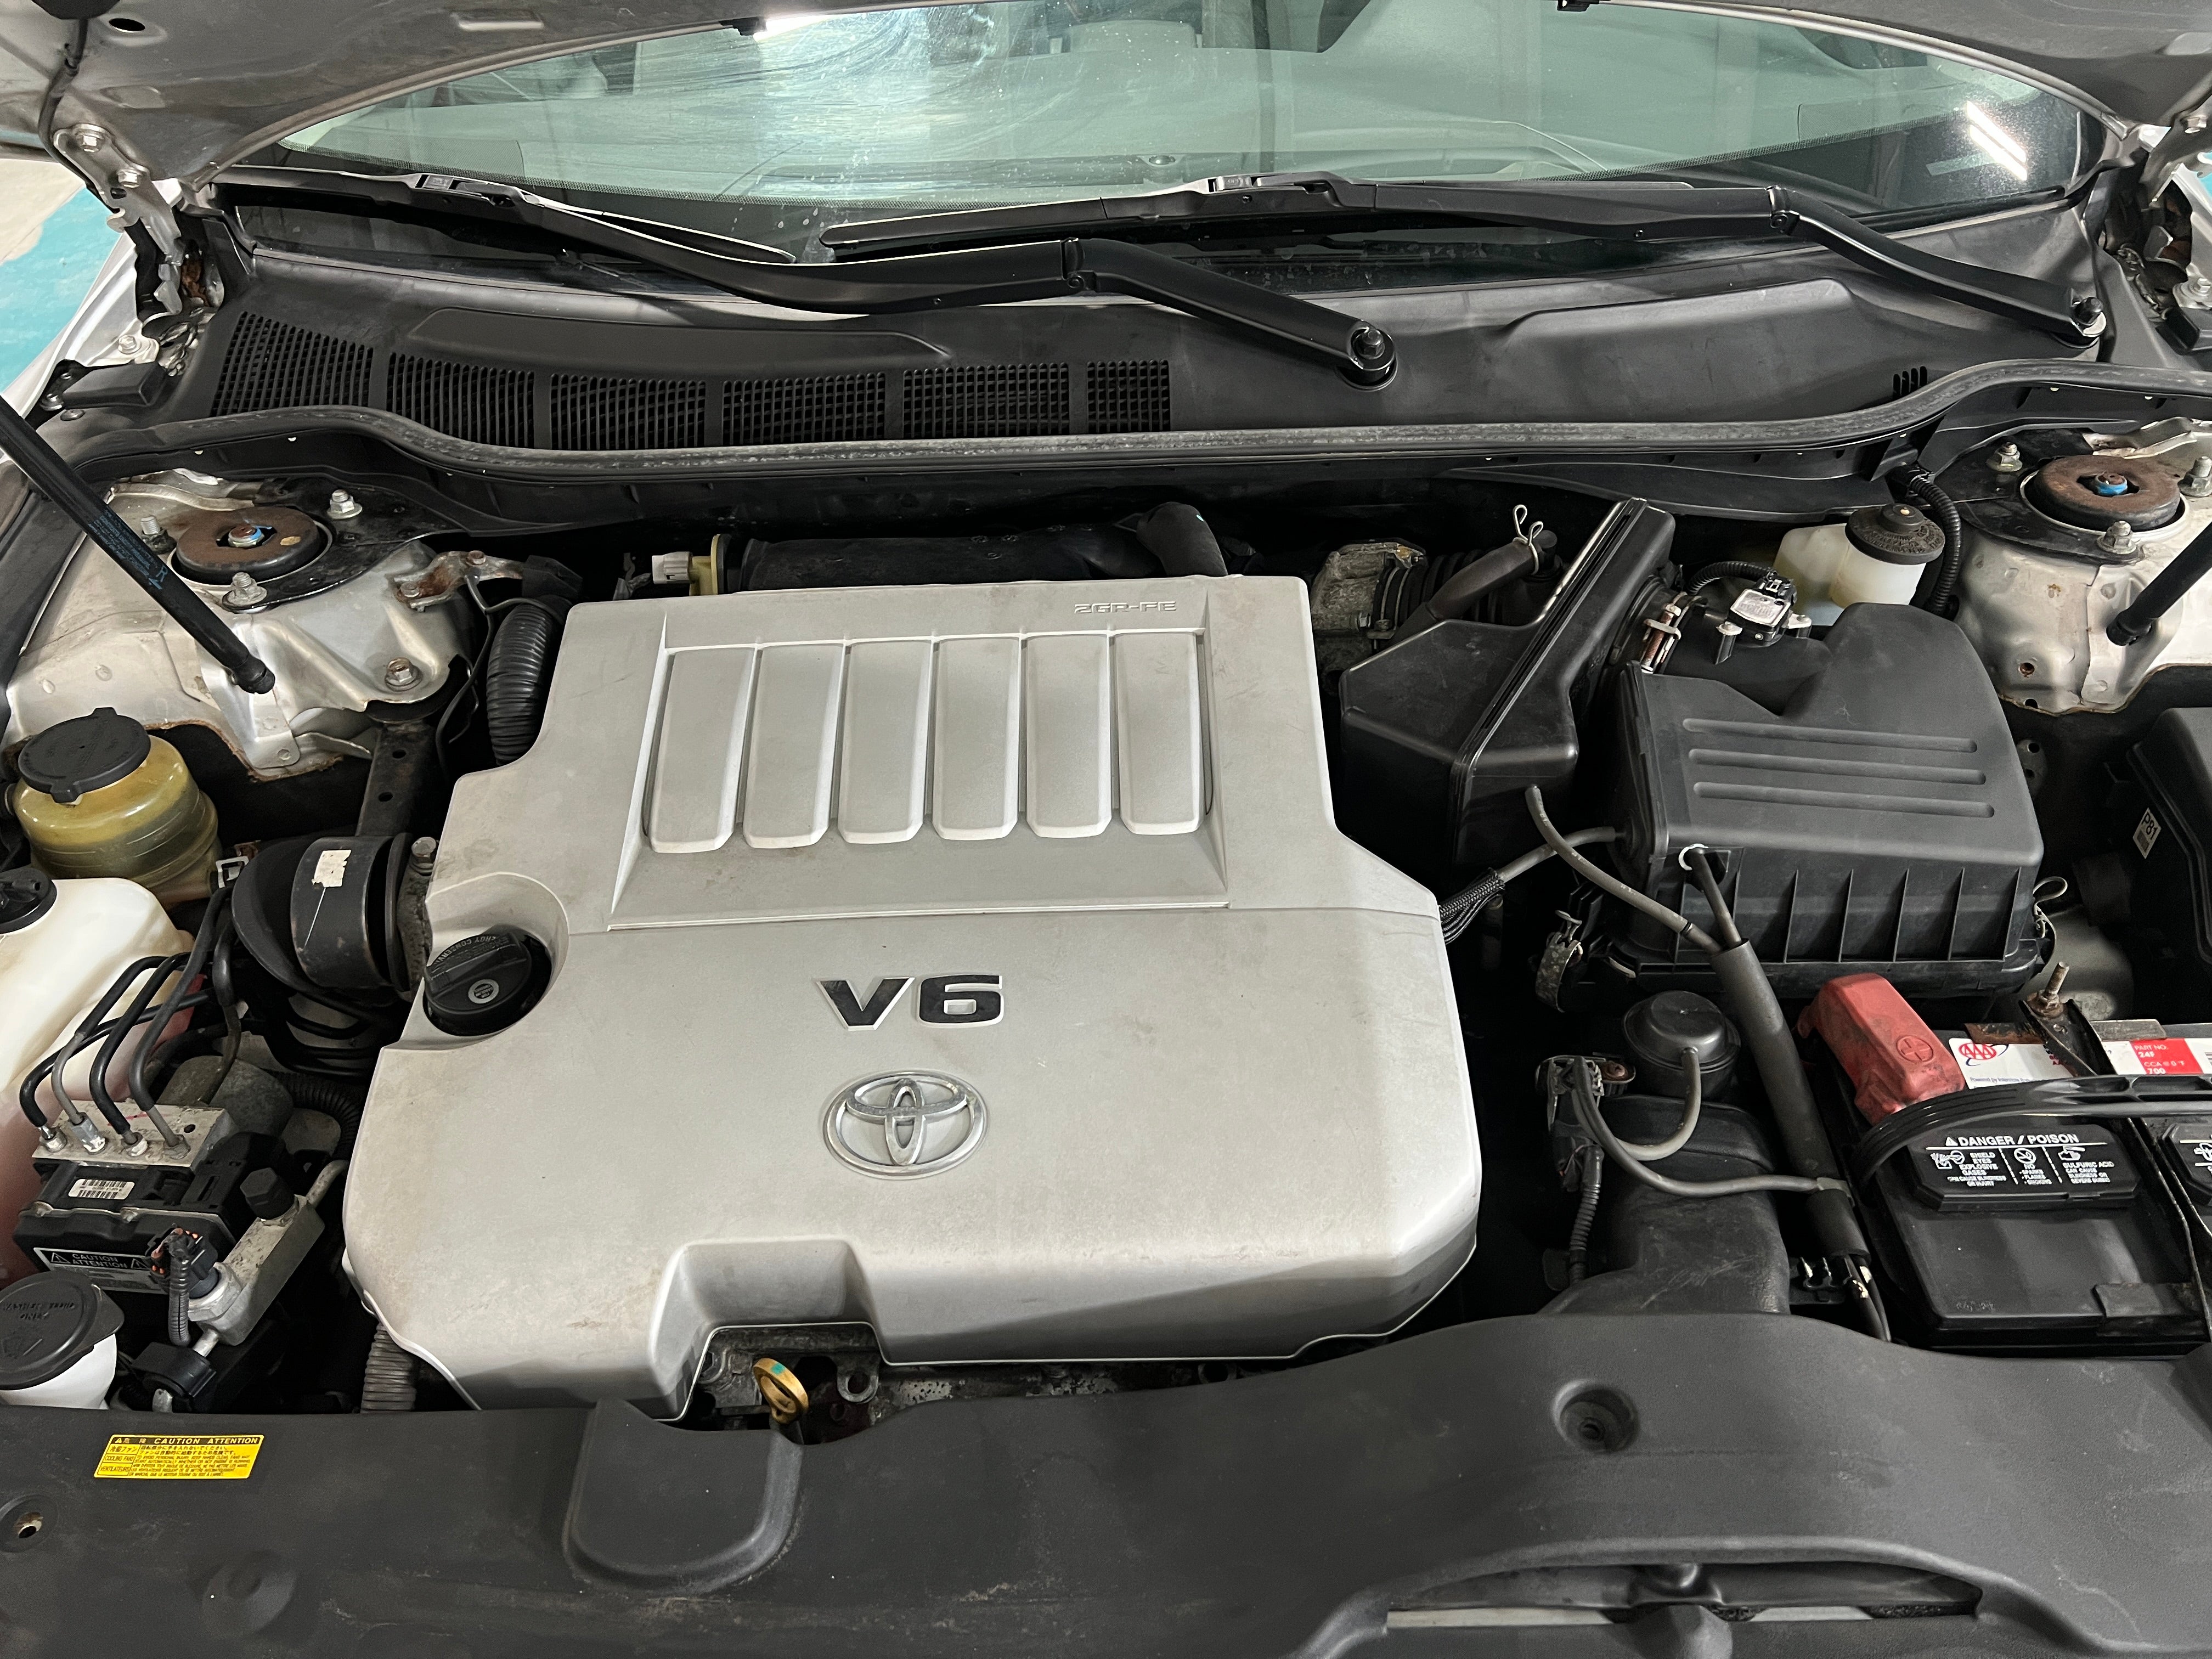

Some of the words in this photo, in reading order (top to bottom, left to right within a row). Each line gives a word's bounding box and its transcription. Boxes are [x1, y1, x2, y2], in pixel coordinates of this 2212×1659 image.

[1074, 601, 1177, 614] 2GR-FE
[2141, 812, 2158, 840] P81
[816, 974, 1005, 1031] V6
[1961, 1043, 1996, 1059] AAA
[1957, 1136, 2015, 1146] DANGER
[2027, 1134, 2079, 1144] POISON
[72, 1254, 117, 1262] CAUTION
[72, 1259, 128, 1268] ATTENTION
